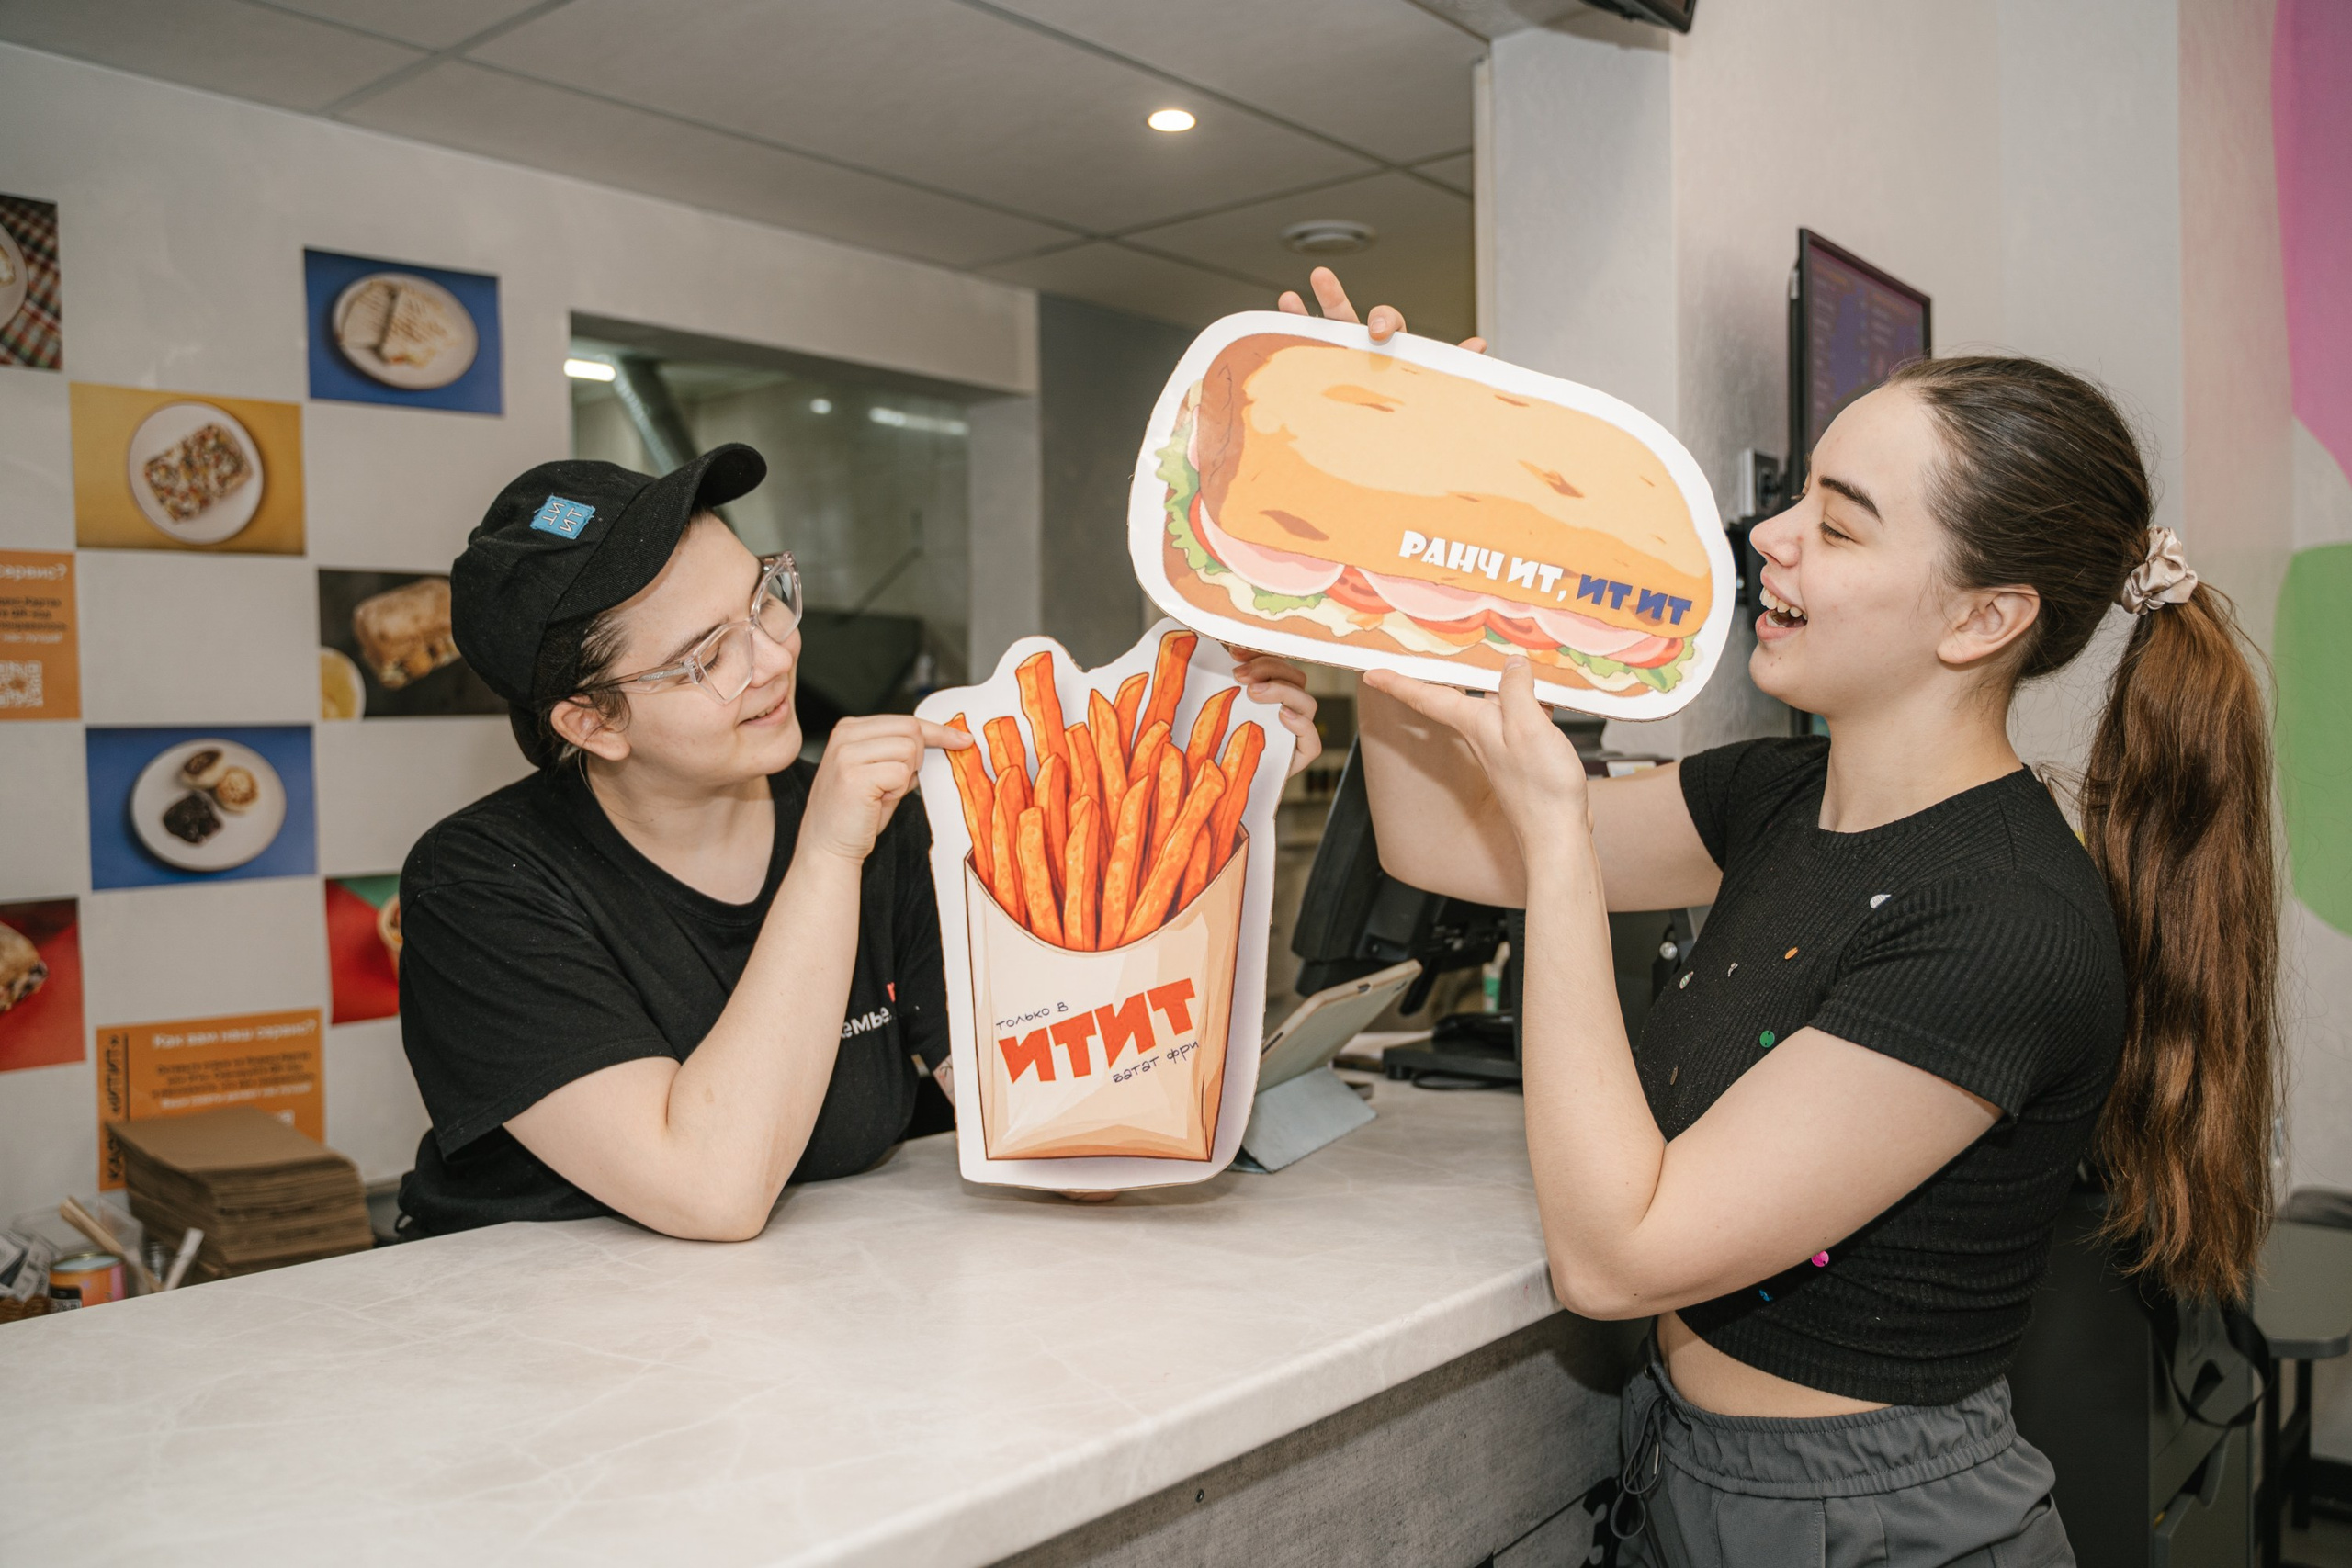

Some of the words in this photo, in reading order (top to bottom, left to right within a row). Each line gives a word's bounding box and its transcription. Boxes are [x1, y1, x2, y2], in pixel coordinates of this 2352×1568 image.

[1398, 530, 1505, 580] РАНЧ
[1507, 557, 1567, 602] ИТ,
[1577, 574, 1633, 610] ИТ
[1635, 588, 1692, 626] ИТ
[840, 1007, 890, 1039] емье
[996, 1008, 1050, 1031] только
[998, 977, 1195, 1084] ИТИТ
[1166, 1041, 1199, 1062] фри
